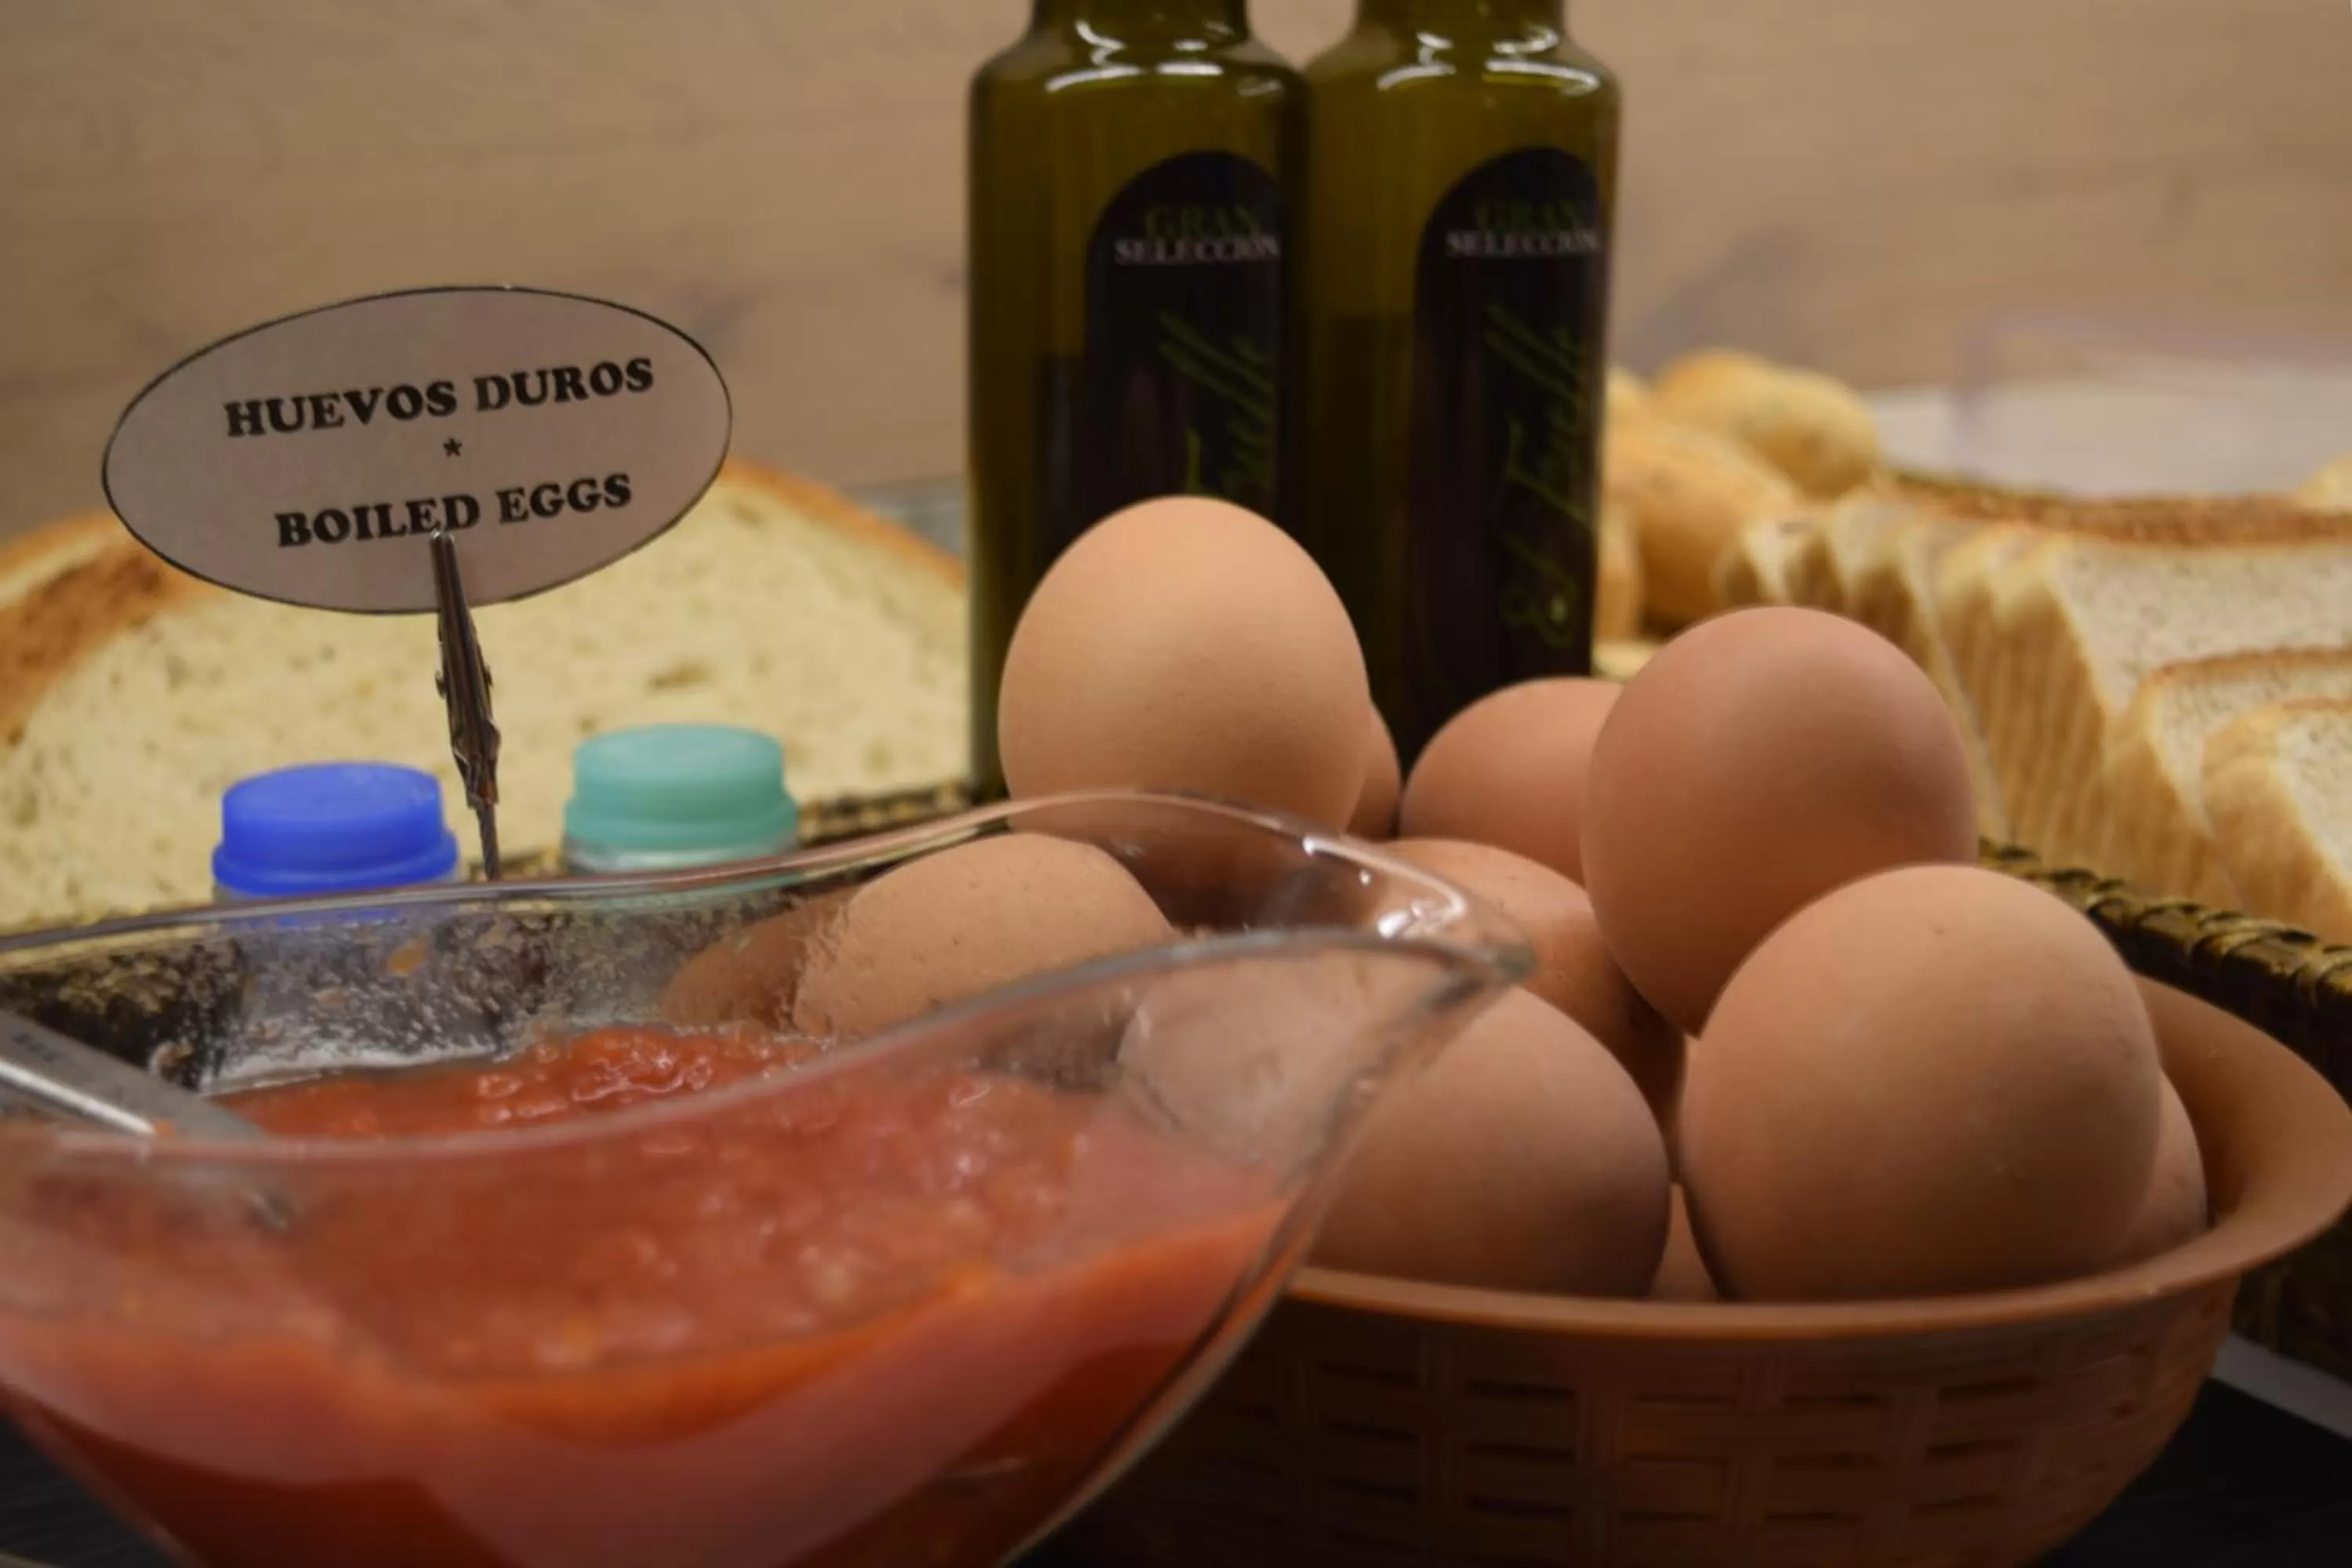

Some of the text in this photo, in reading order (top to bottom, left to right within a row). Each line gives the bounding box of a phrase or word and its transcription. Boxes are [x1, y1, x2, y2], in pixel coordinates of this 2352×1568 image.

[223, 357, 655, 438] HUEVOS DUROS
[274, 471, 633, 549] BOILED EGGS
